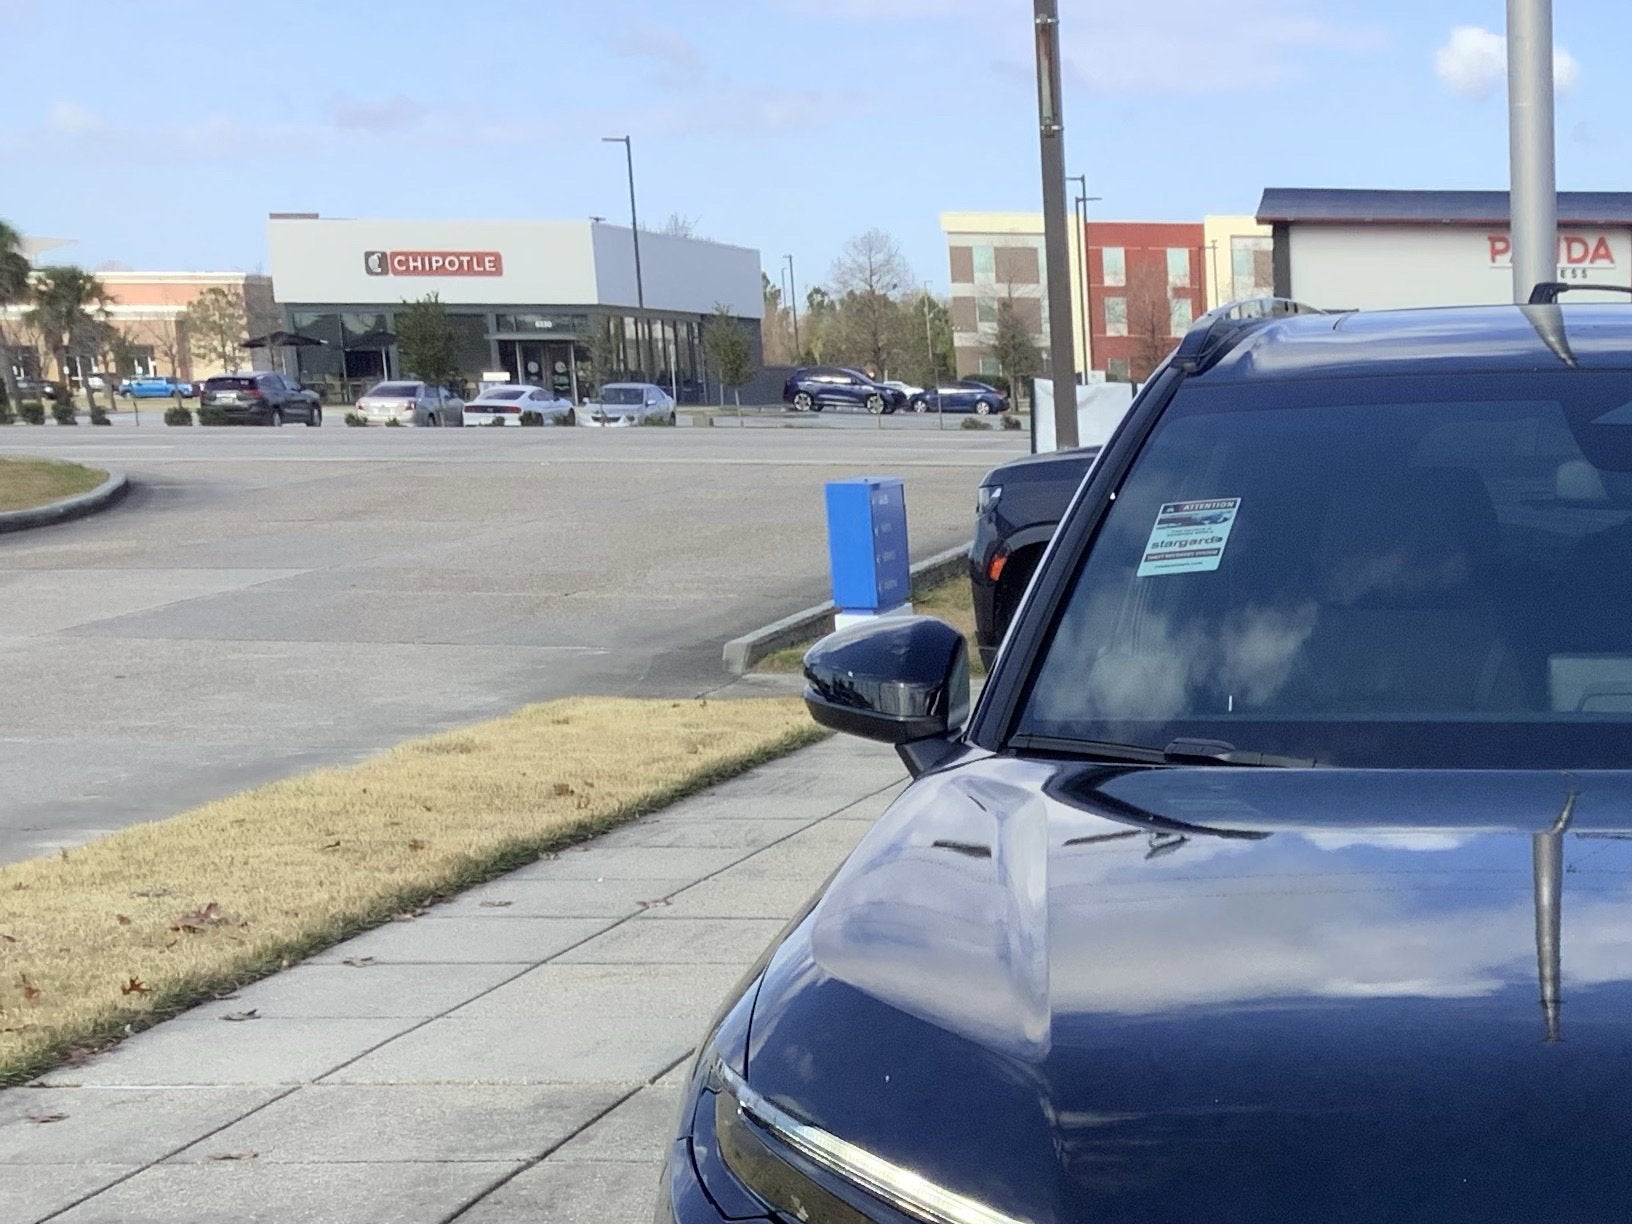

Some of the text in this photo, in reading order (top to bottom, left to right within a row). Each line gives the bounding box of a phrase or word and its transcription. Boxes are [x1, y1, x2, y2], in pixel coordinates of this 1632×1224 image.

[1487, 234, 1616, 265] PDA
[393, 255, 497, 272] CHIPOTLE
[1183, 500, 1236, 512] ATTENTION
